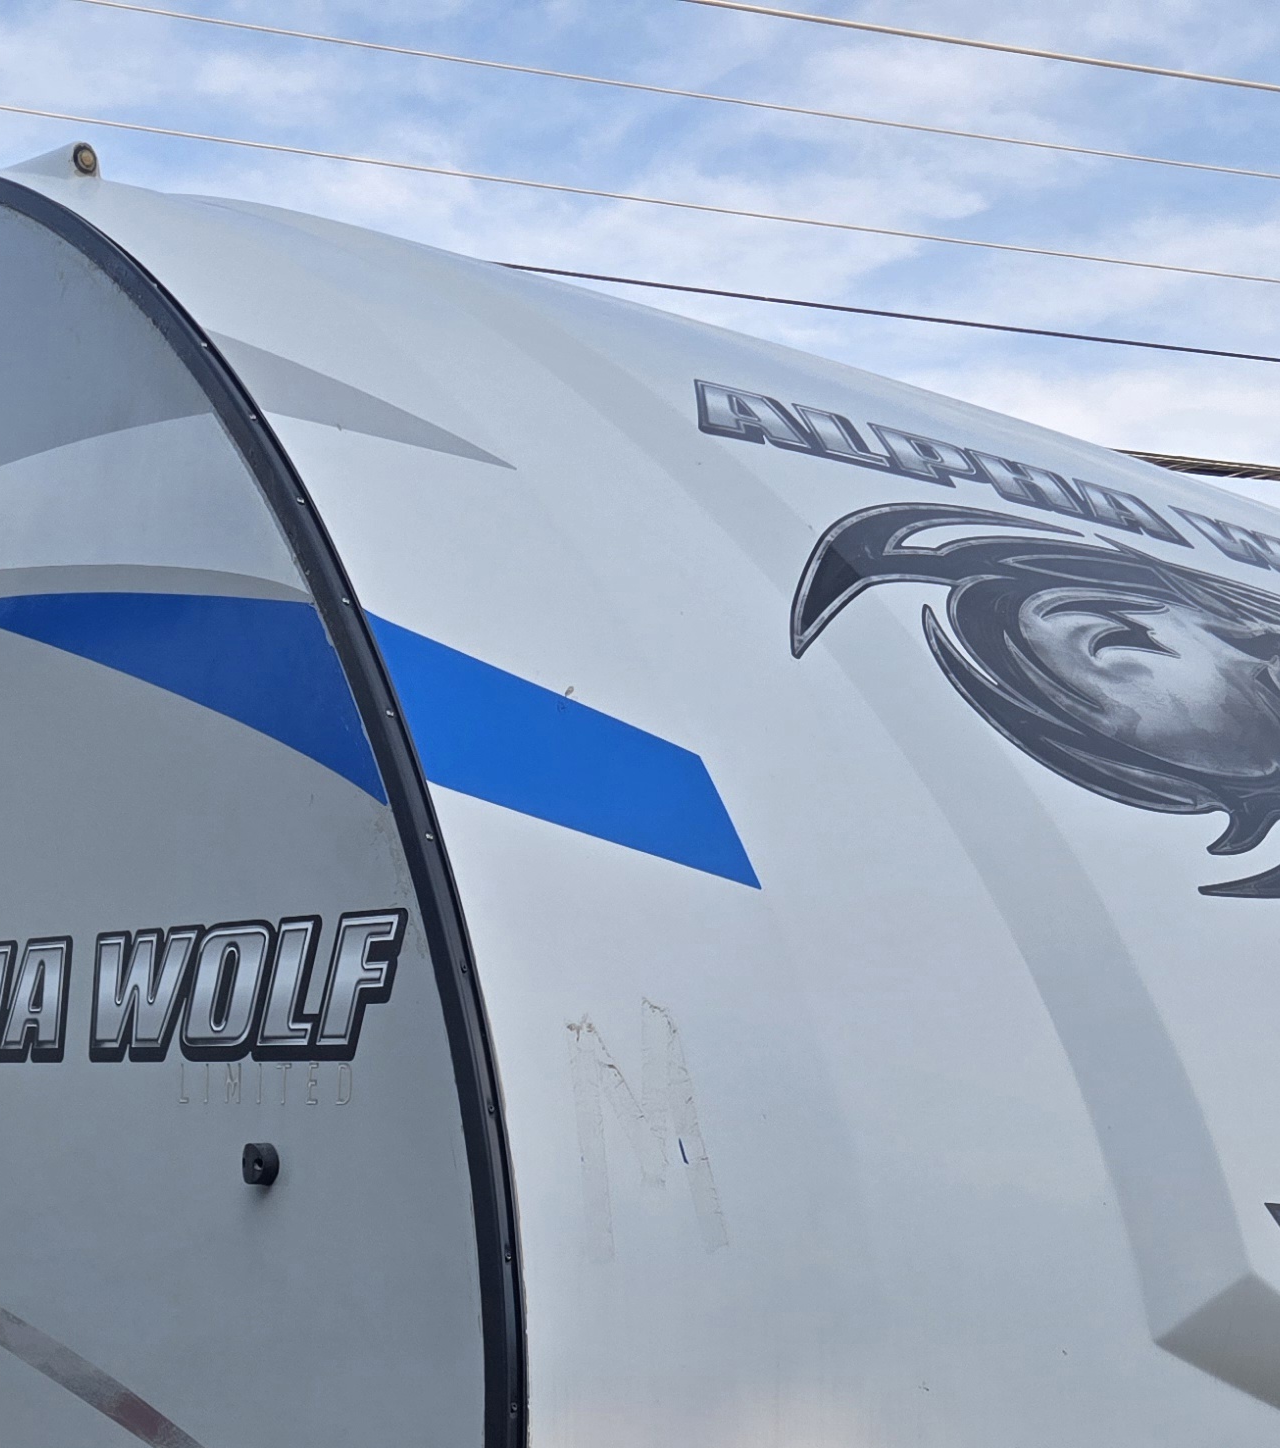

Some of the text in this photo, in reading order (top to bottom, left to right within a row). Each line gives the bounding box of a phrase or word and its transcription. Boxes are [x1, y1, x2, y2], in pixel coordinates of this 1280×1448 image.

[694, 379, 1190, 547] ALPHA
[88, 908, 408, 1062] WOLF
[178, 1062, 353, 1105] LIMITED
